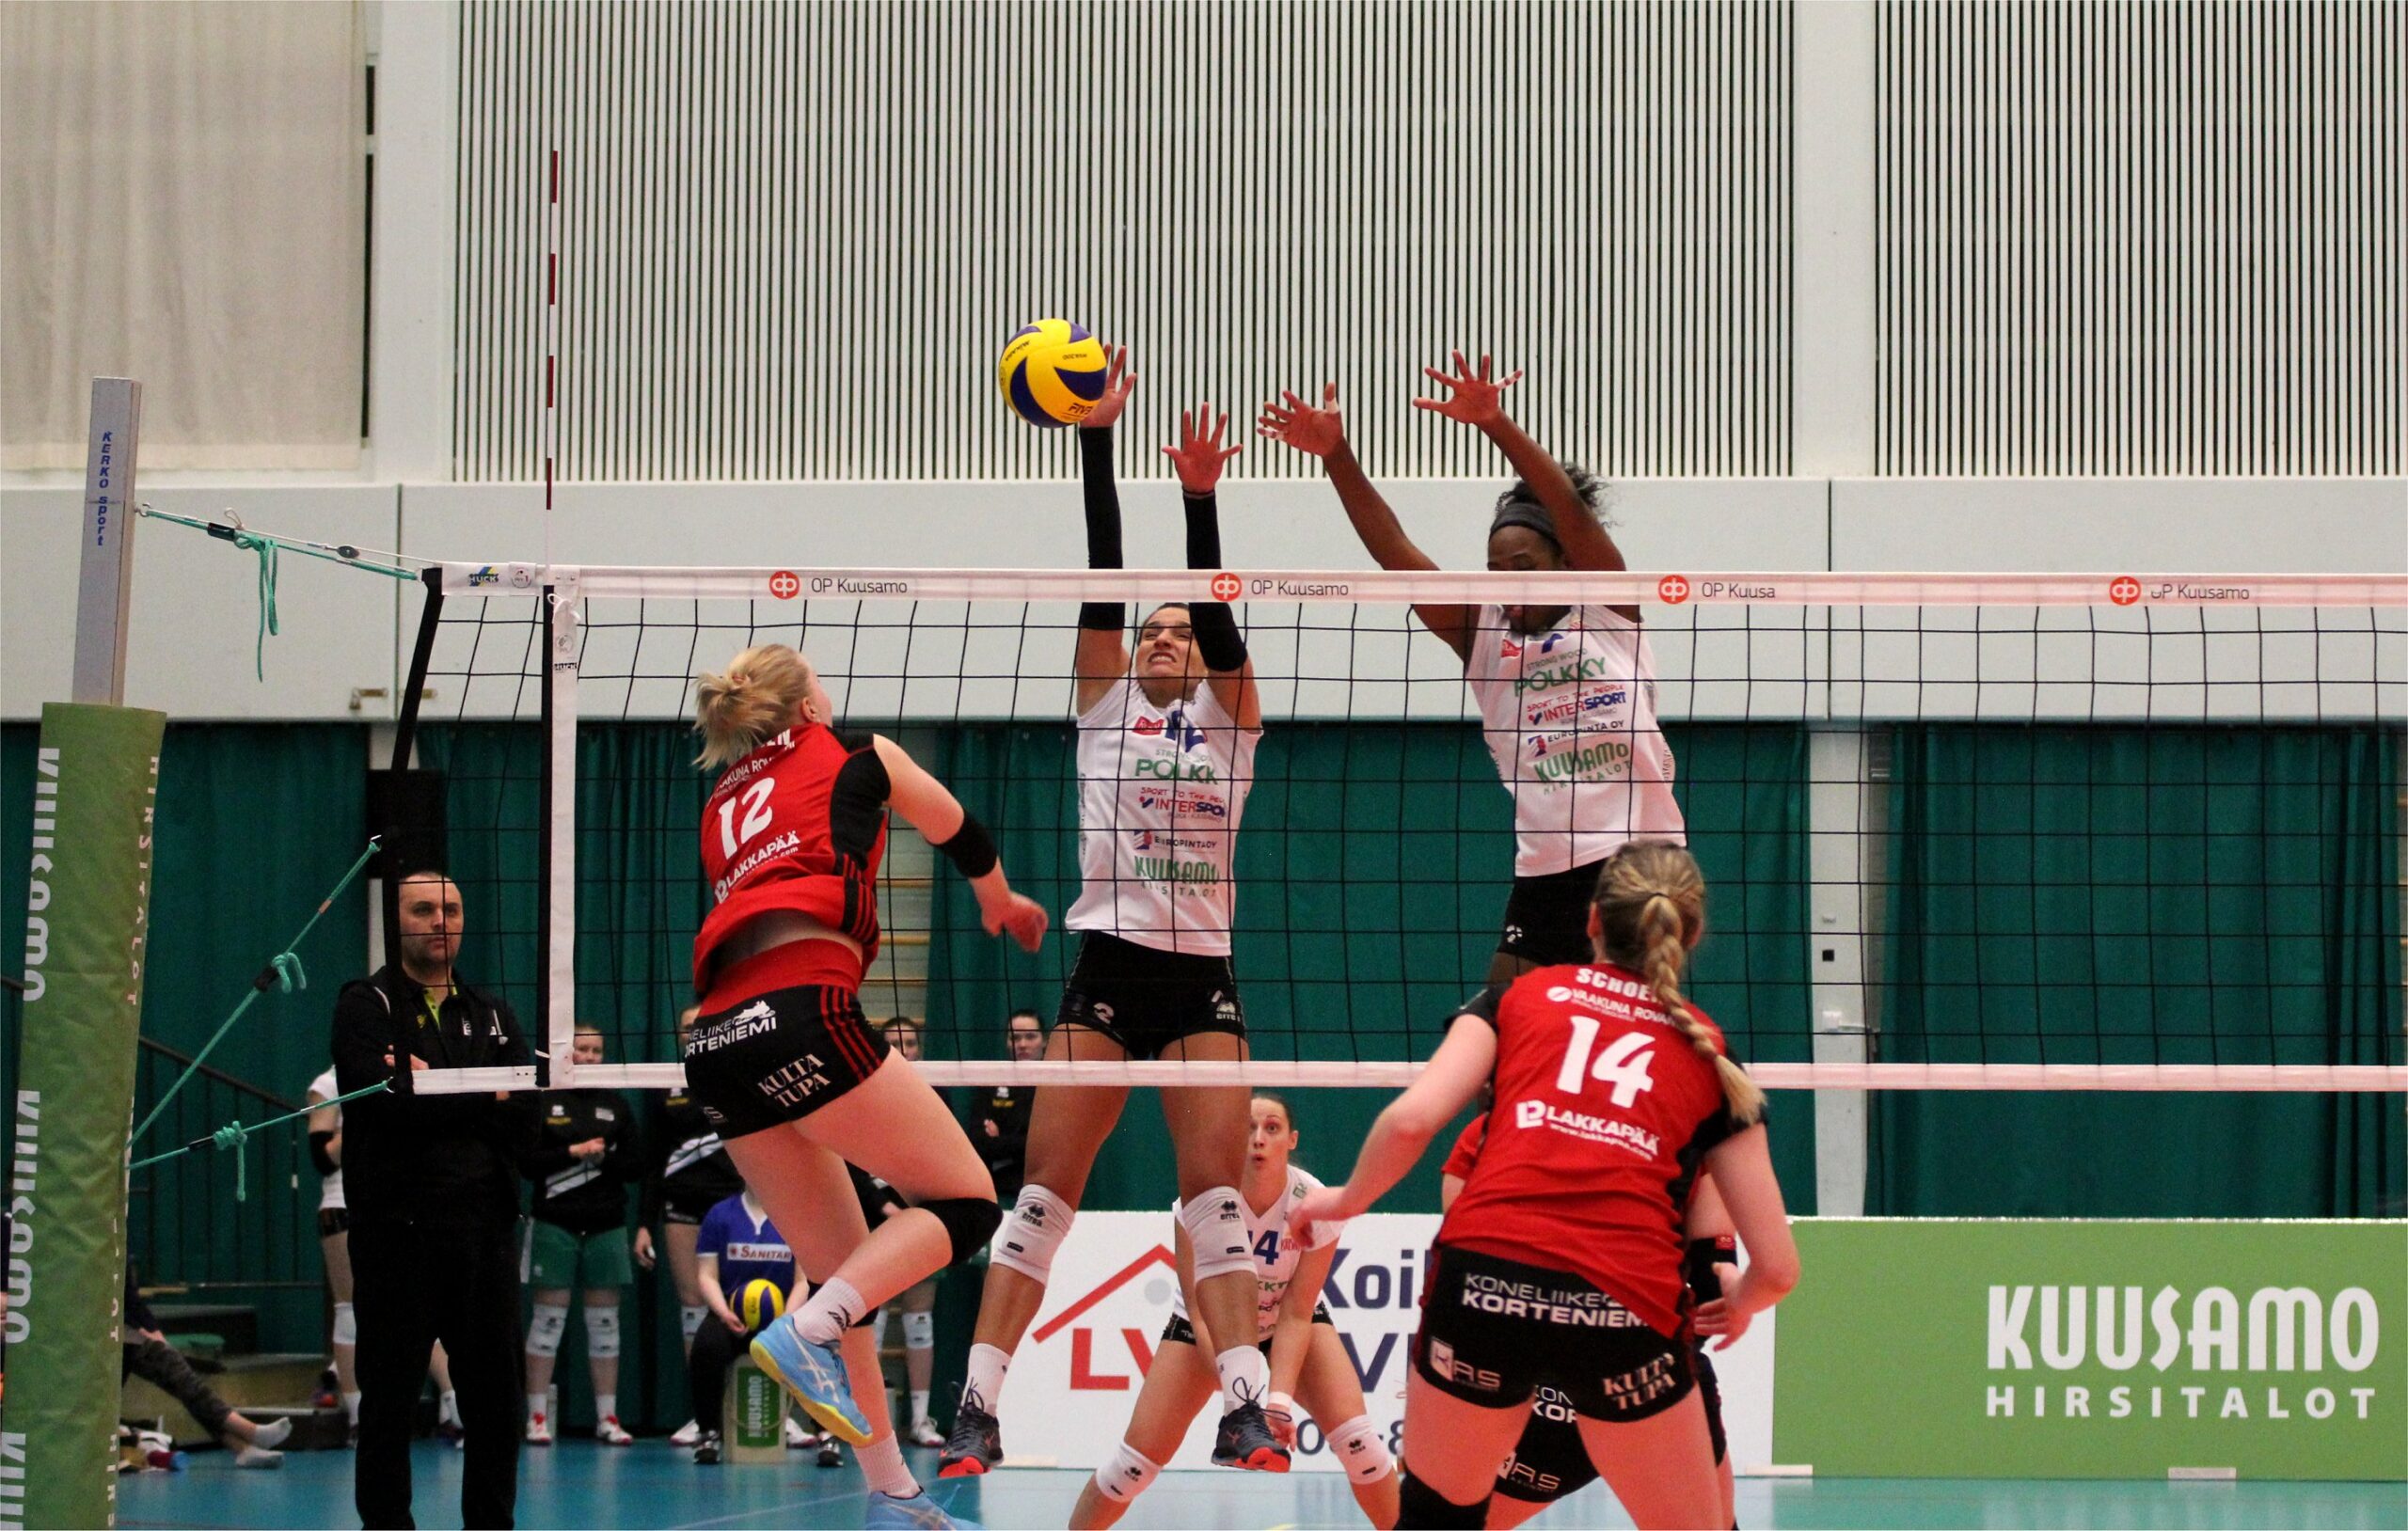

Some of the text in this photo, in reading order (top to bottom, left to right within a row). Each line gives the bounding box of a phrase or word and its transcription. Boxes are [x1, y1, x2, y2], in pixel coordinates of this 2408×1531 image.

[97, 431, 113, 545] KERKO sport
[812, 578, 908, 593] OP Kuusamo
[1251, 580, 1349, 596] OP Kuusamo
[1702, 582, 1724, 597] OP
[2178, 584, 2249, 600] Kuusamo
[1514, 656, 1606, 697] POLKKY
[1543, 691, 1626, 721] INTERSPORT
[1610, 719, 1624, 729] OY
[1534, 742, 1629, 781] KUUSAMO
[718, 777, 776, 860] 12
[726, 829, 801, 888] LAKKAPÄÄ
[127, 756, 160, 1005] HIRSITALOT
[1572, 987, 1631, 1016] VAAKUNA
[757, 1053, 825, 1097] KULTA
[1556, 1015, 1656, 1109] 14
[774, 1073, 831, 1108] TUPA
[1546, 1106, 1660, 1157] LAKKAPÄÄ
[1323, 1248, 1434, 1309] Koi
[1465, 1272, 1605, 1308] KONELIIKE
[1988, 1285, 2380, 1372] KUUSAMO
[1987, 1385, 2376, 1419] HIRSITALOT
